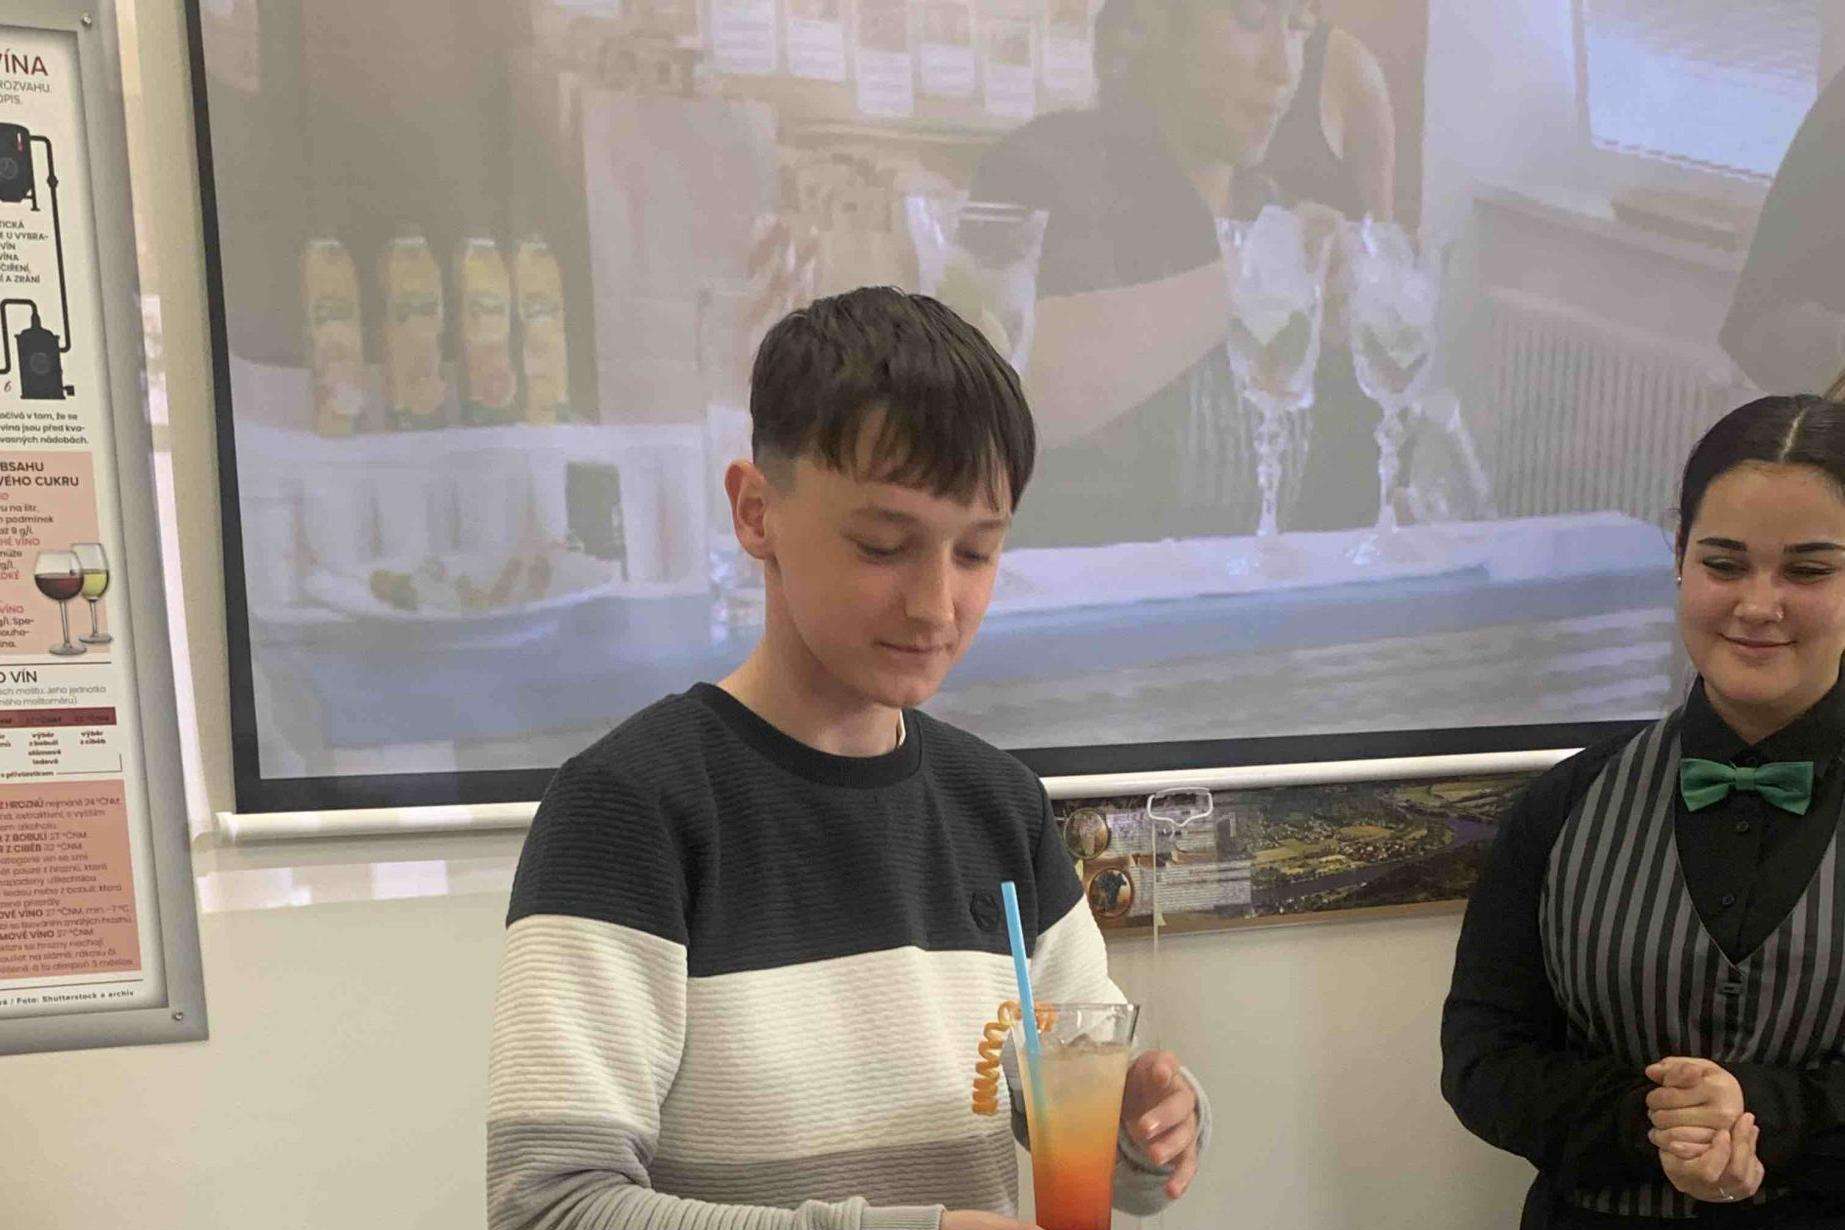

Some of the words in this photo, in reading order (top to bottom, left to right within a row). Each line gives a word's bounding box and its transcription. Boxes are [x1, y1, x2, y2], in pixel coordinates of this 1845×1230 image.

[0, 48, 48, 76] ÍNA
[4, 380, 12, 392] 6
[0, 461, 44, 472] BSAHU
[35, 476, 79, 487] CUKRU
[10, 669, 38, 683] VÍN
